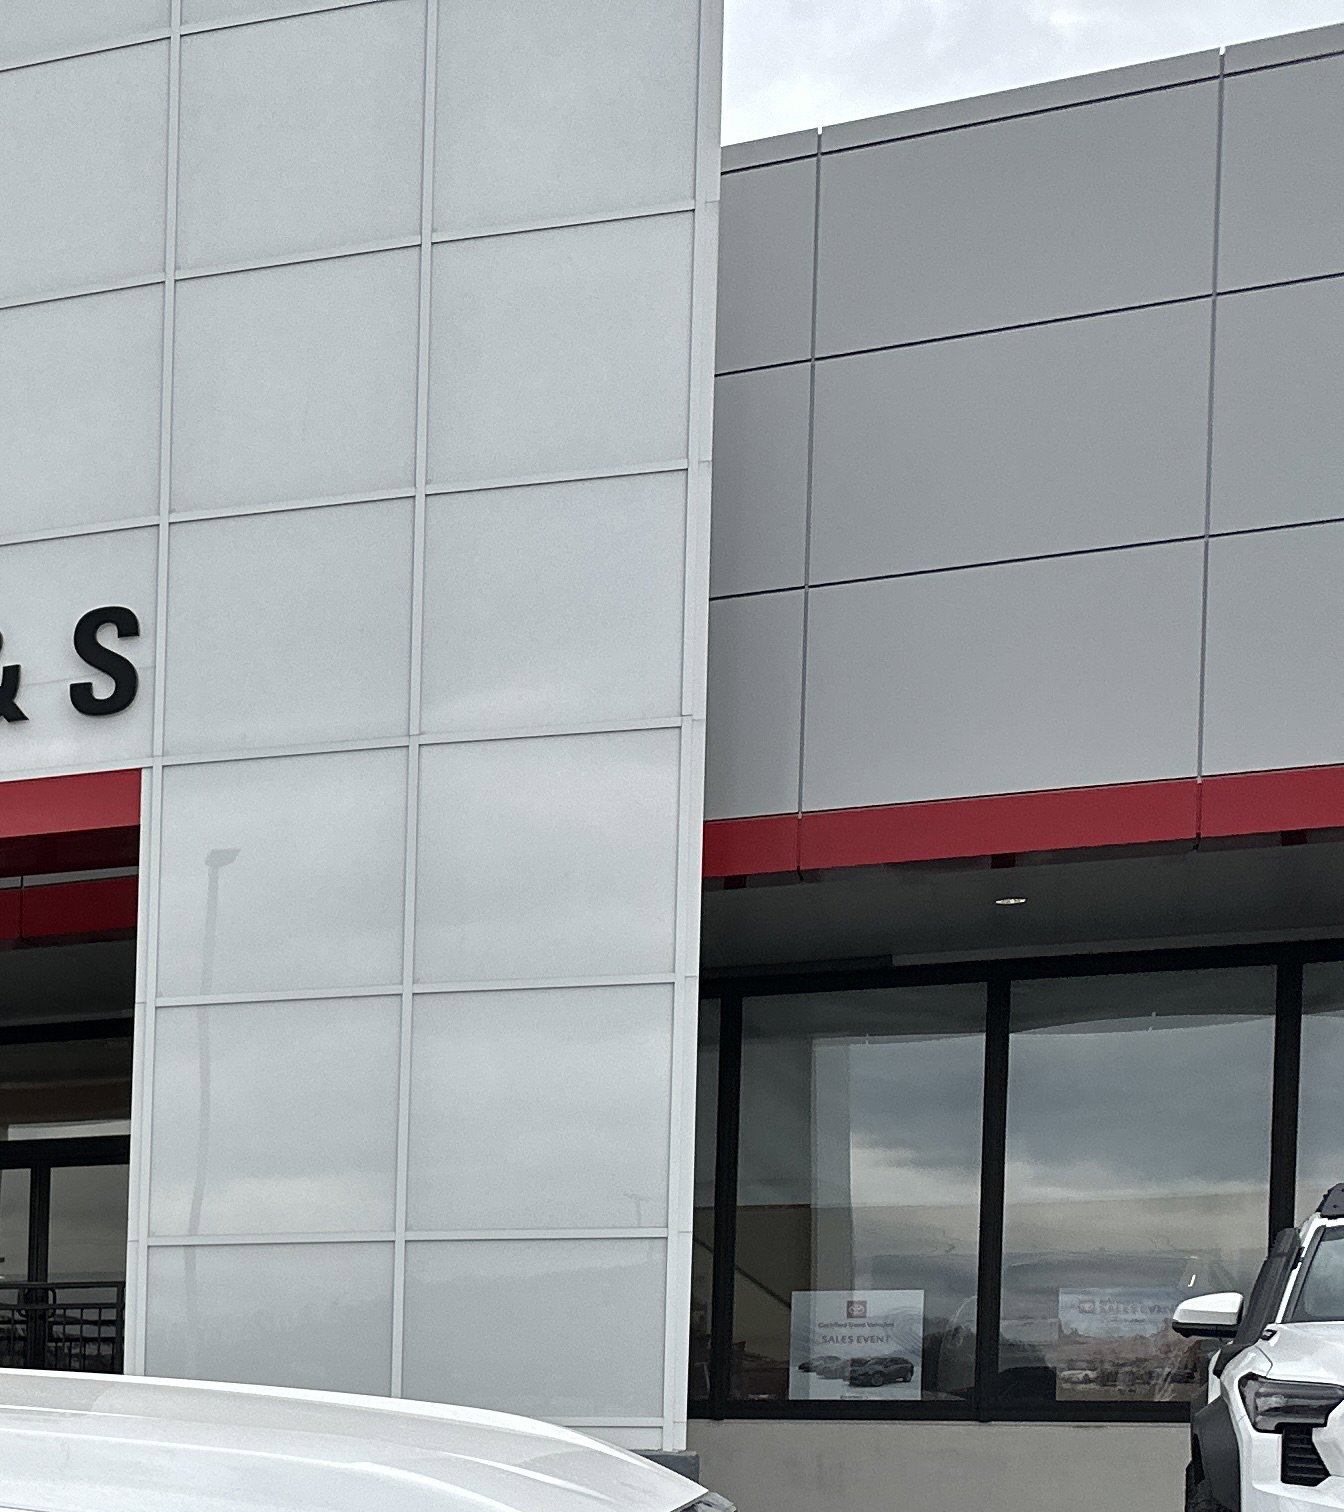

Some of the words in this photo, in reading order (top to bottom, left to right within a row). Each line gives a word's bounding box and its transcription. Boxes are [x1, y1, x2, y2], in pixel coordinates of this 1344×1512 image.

[69, 605, 141, 717] S
[821, 1335, 854, 1345] SALES
[856, 1335, 890, 1345] EVENT
